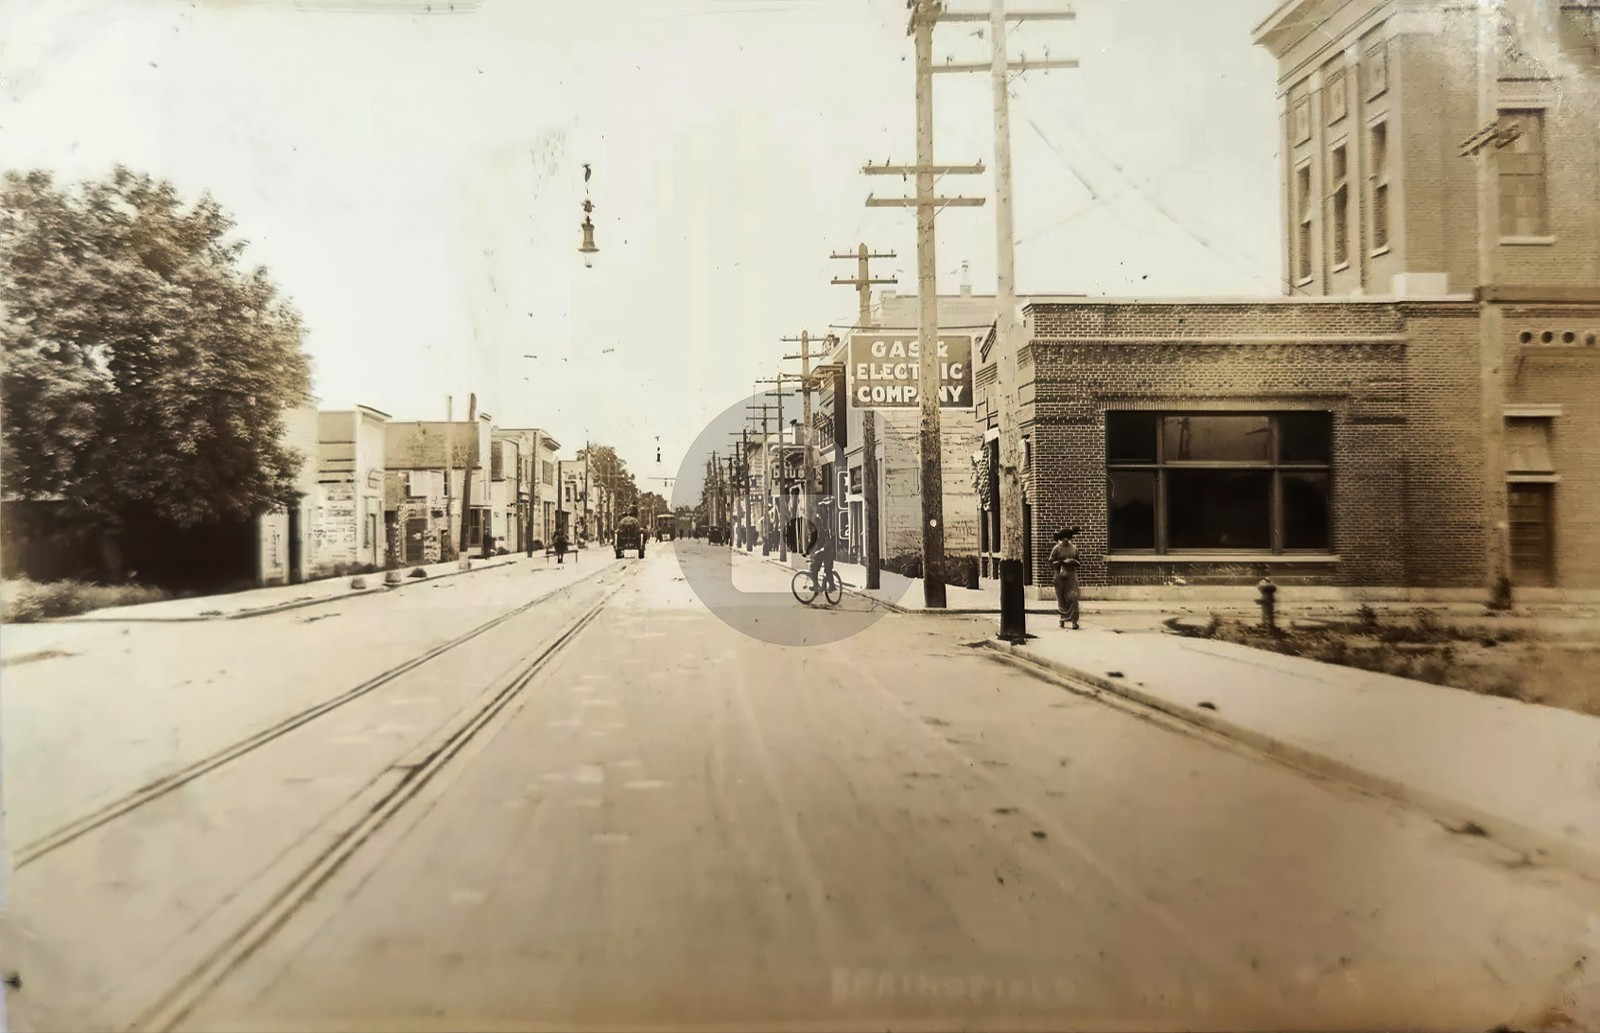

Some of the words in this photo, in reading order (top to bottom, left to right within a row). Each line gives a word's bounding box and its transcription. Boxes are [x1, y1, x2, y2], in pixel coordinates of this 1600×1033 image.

[871, 340, 919, 358] GAS
[856, 363, 963, 380] ELECTIC
[857, 386, 964, 403] COMPNY
